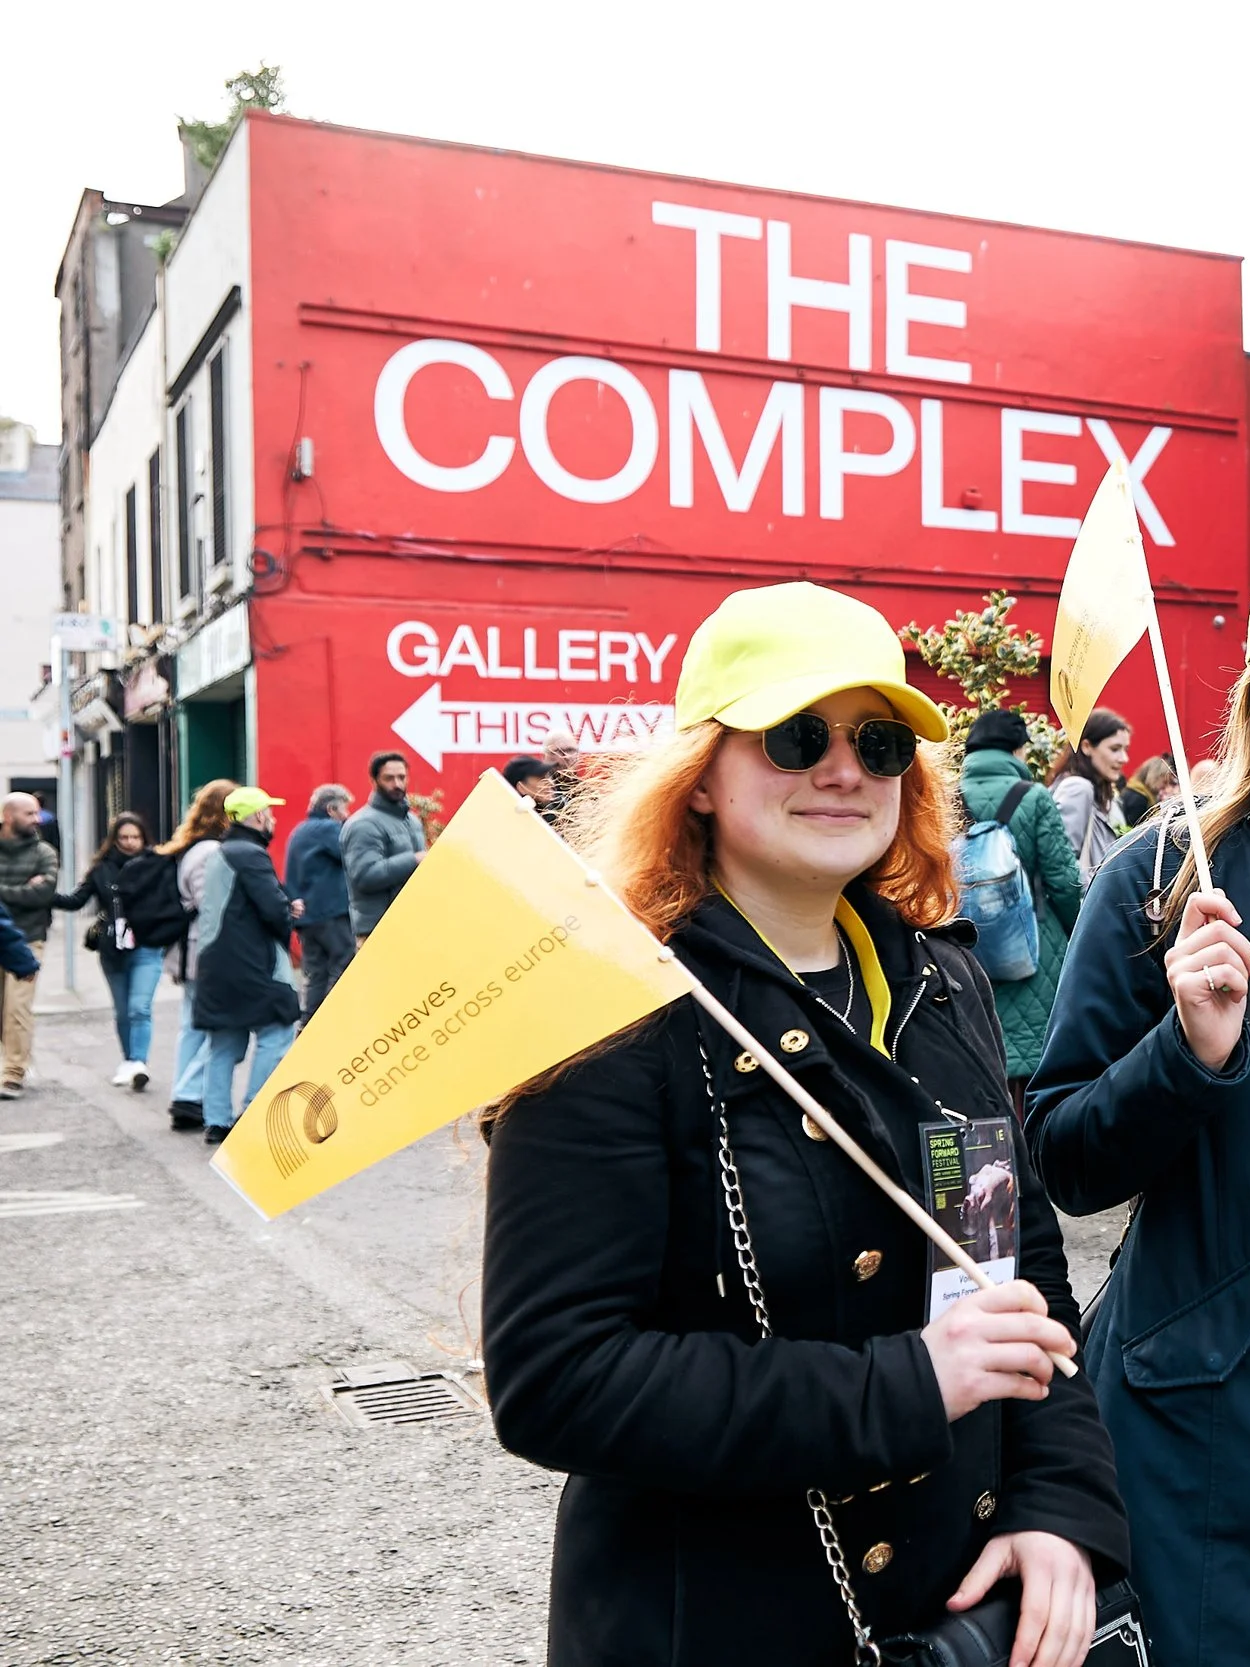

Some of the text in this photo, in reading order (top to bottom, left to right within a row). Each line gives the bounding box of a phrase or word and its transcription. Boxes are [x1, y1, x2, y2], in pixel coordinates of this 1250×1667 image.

[652, 201, 972, 384] THE
[374, 338, 1176, 547] COMPLEX
[386, 620, 678, 683] GALLERY
[439, 710, 664, 745] THIS WAY
[337, 981, 456, 1085] aerowaves
[359, 914, 581, 1107] dance across europe
[929, 1138, 954, 1149] SPRING
[931, 1147, 960, 1159] FORWARD
[932, 1157, 960, 1168] FESTIVAL
